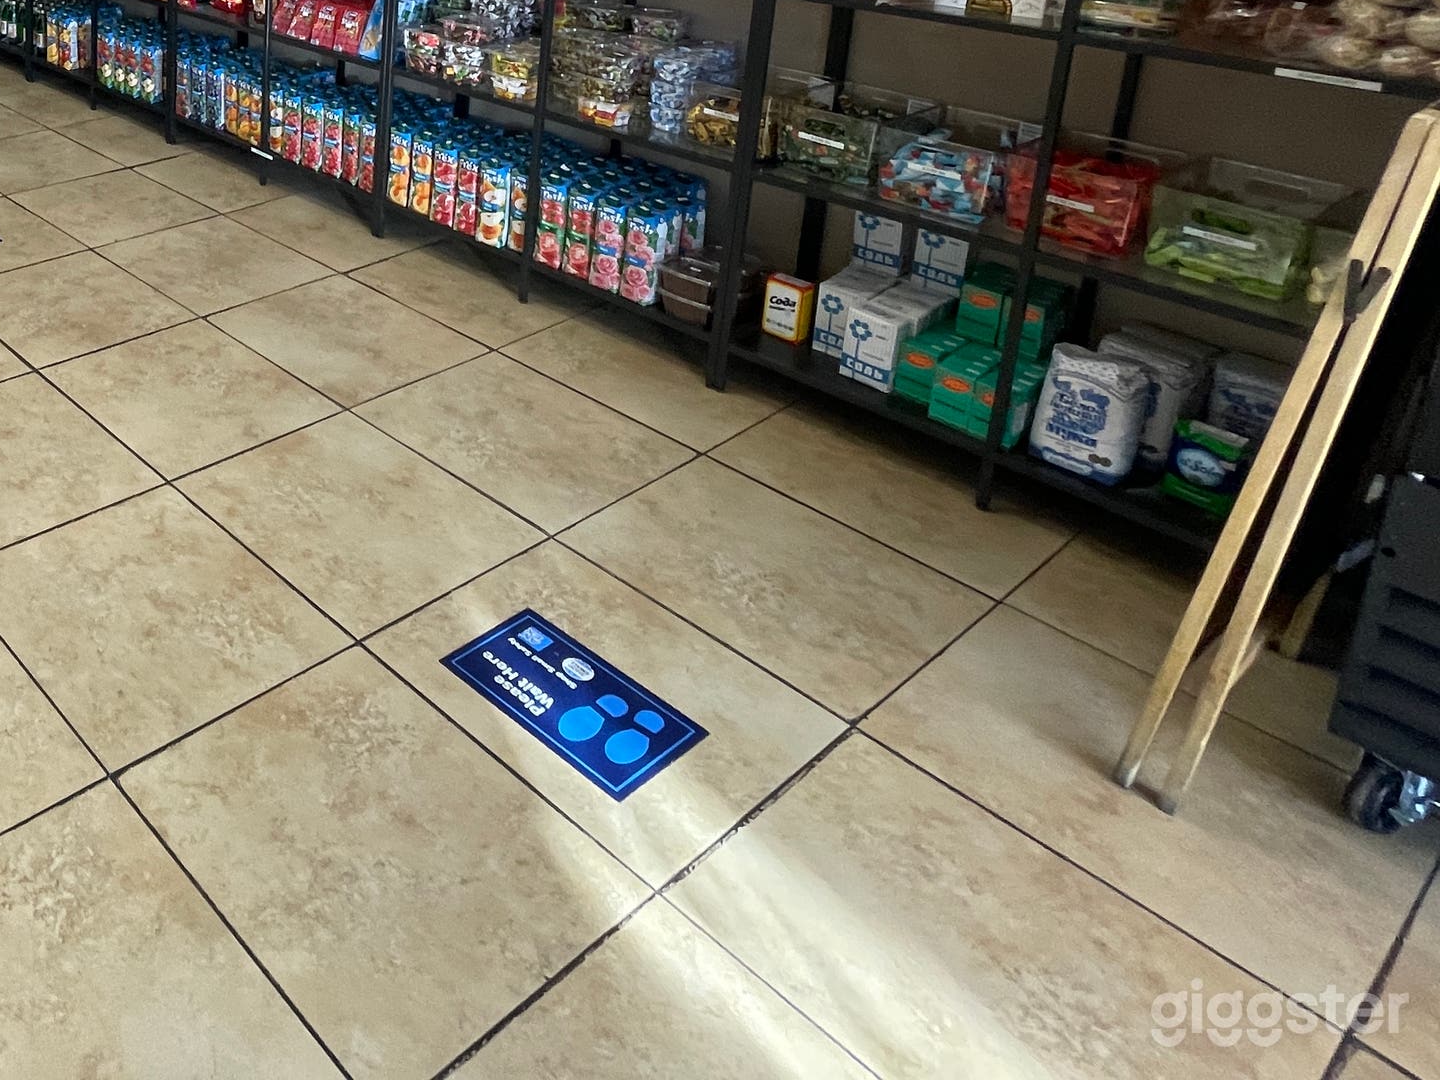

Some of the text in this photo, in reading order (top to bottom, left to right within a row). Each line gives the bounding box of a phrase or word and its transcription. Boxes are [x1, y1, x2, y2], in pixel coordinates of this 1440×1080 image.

[858, 248, 894, 266] СОЛЬ
[919, 266, 957, 285] СОЛЬ
[820, 333, 844, 346] СОЛ
[847, 358, 883, 380] СОЛЬ
[482, 650, 554, 710] Wait Here
[494, 675, 546, 716] Please
